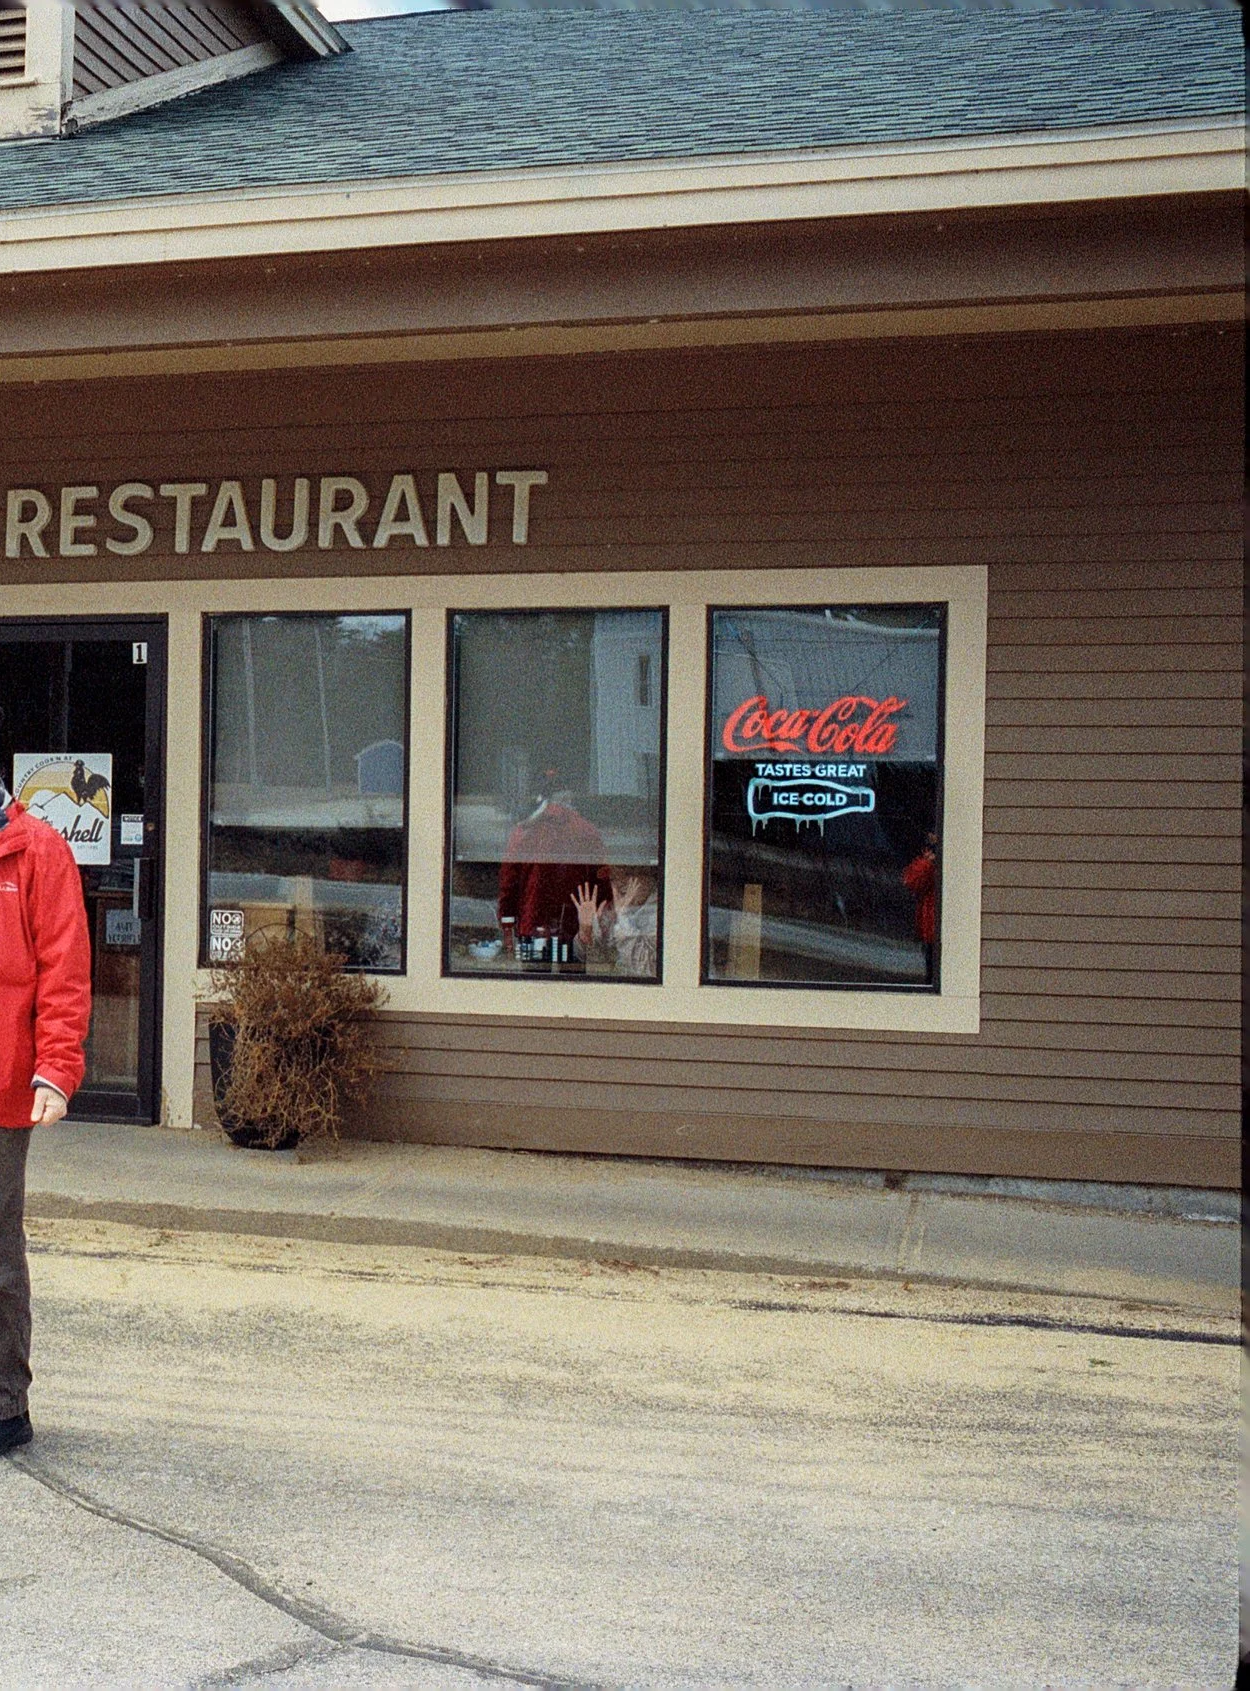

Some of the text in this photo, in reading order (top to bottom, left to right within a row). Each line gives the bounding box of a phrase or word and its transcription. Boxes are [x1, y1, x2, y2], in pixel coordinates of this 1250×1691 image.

[5, 471, 548, 559] RESTAURANT
[722, 695, 908, 754] Coca-Cola
[755, 763, 867, 777] TASTES GREAT
[15, 767, 35, 794] OUNTRY
[772, 792, 848, 806] ICE COLD
[60, 815, 104, 843] shell
[213, 913, 231, 925] NO
[213, 937, 231, 951] NO
